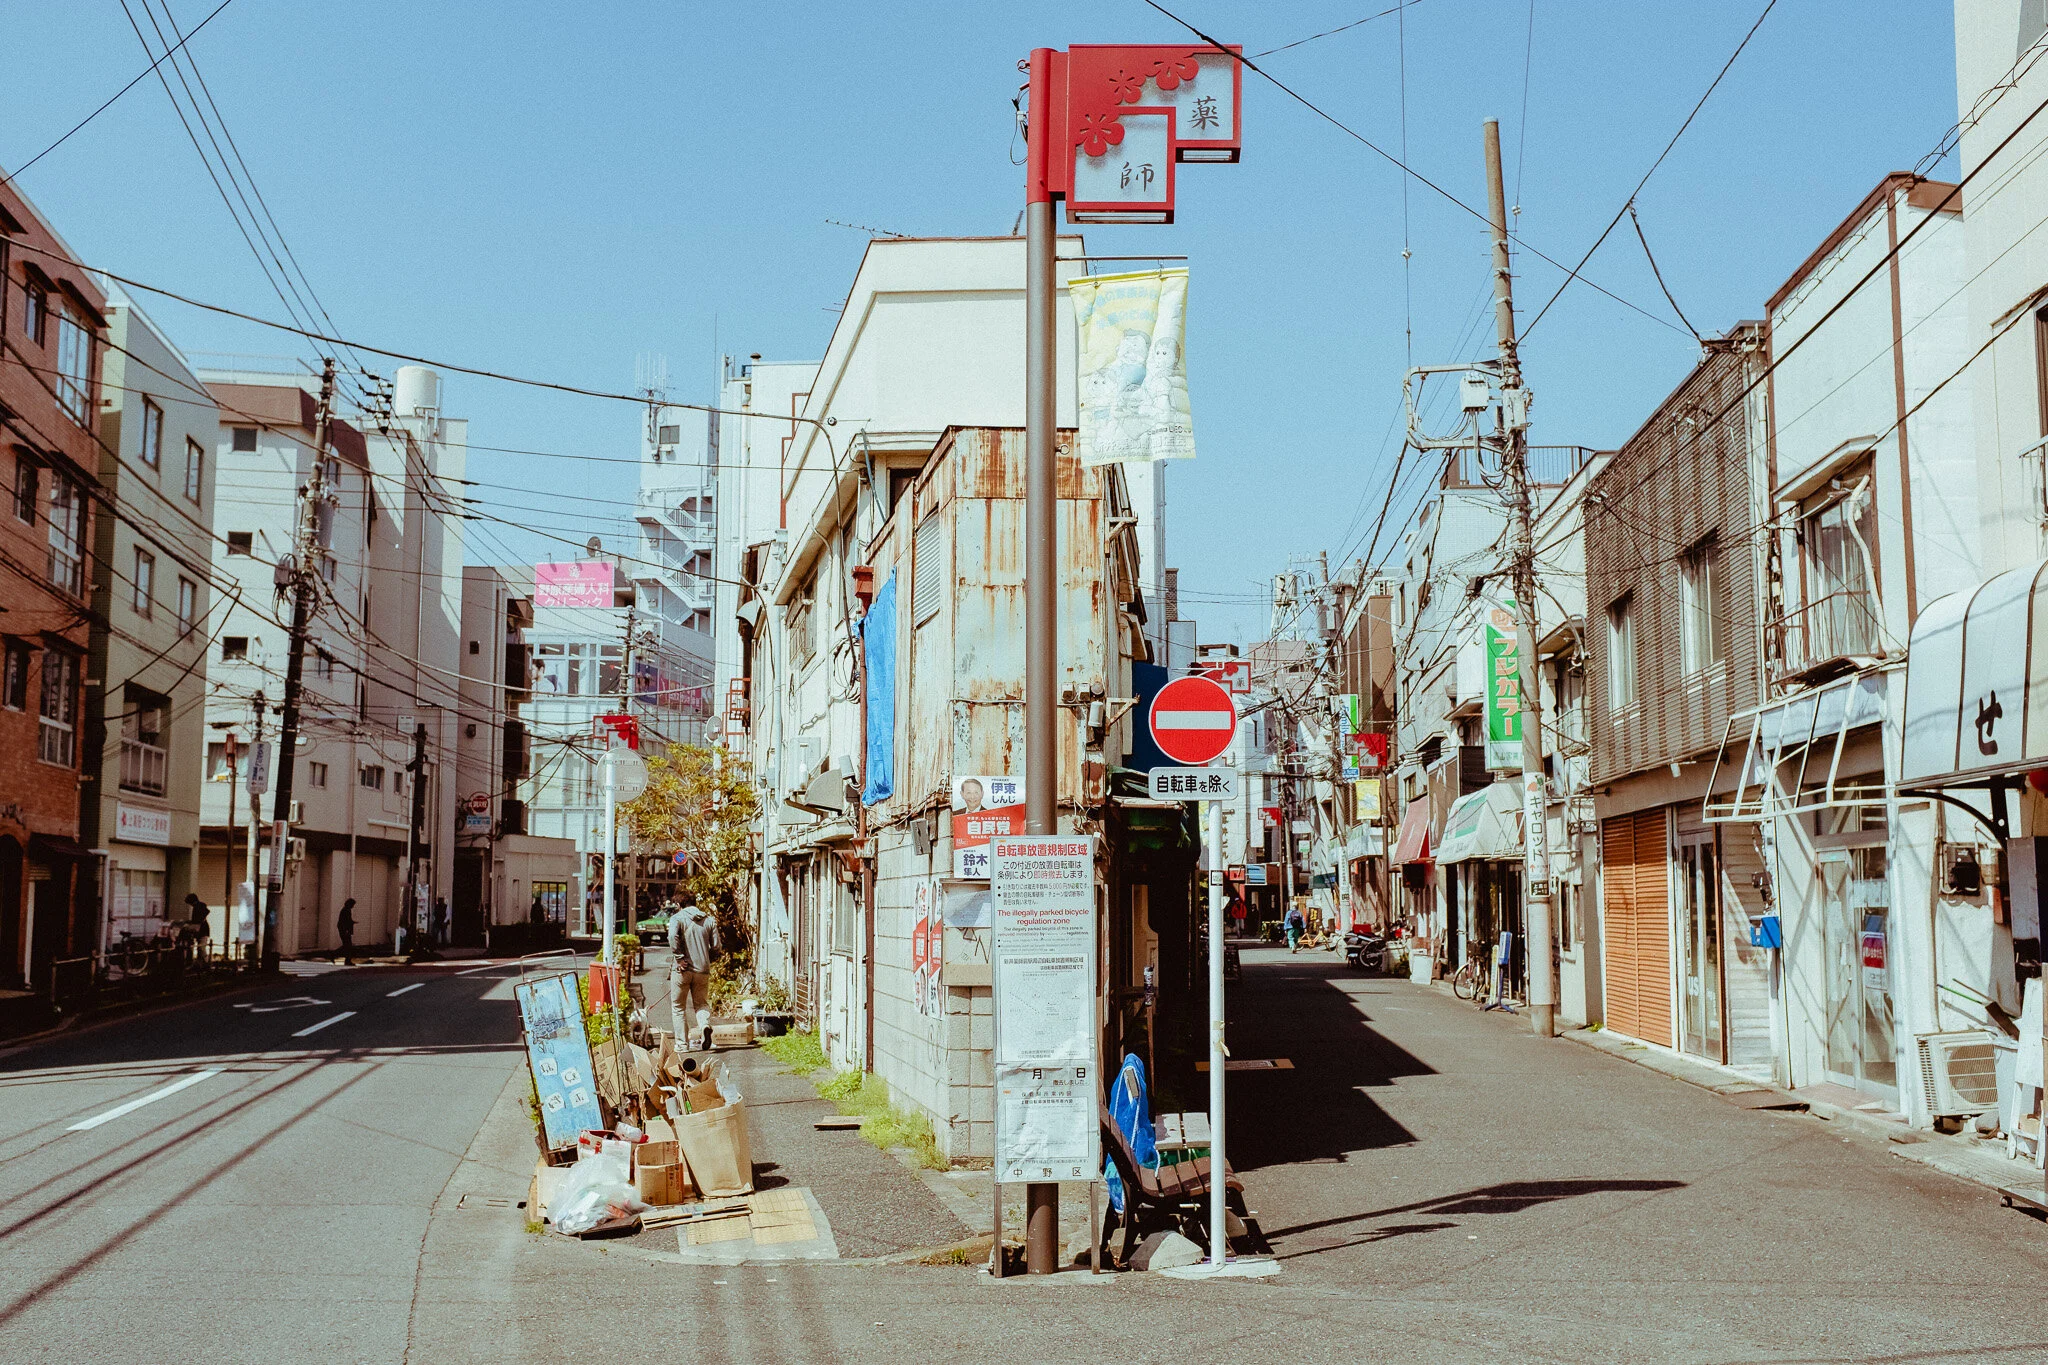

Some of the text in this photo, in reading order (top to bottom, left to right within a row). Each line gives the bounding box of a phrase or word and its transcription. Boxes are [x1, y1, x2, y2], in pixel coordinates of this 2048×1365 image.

[1187, 95, 1220, 130] 薬
[1119, 161, 1155, 192] 師
[1493, 638, 1522, 736] フジカラー
[1975, 690, 2003, 756] せ
[991, 782, 1017, 794] 伊東
[1156, 775, 1231, 794] 自転車を除く
[992, 795, 1016, 804] しんじ
[967, 821, 1011, 835] 自民党
[997, 843, 1088, 857] 自転車放置規制区域
[963, 854, 988, 866] 鈴木
[1003, 860, 1082, 870] この付近の放置自転車は
[997, 870, 1088, 880] 条例により即時撤去します。
[1012, 909, 1038, 917] illegally
[1040, 909, 1064, 918] parked
[1065, 909, 1089, 917] bicycle
[1016, 918, 1052, 926] regulation
[1032, 1068, 1086, 1079] 月 日
[1013, 1167, 1082, 1178] 中野区
